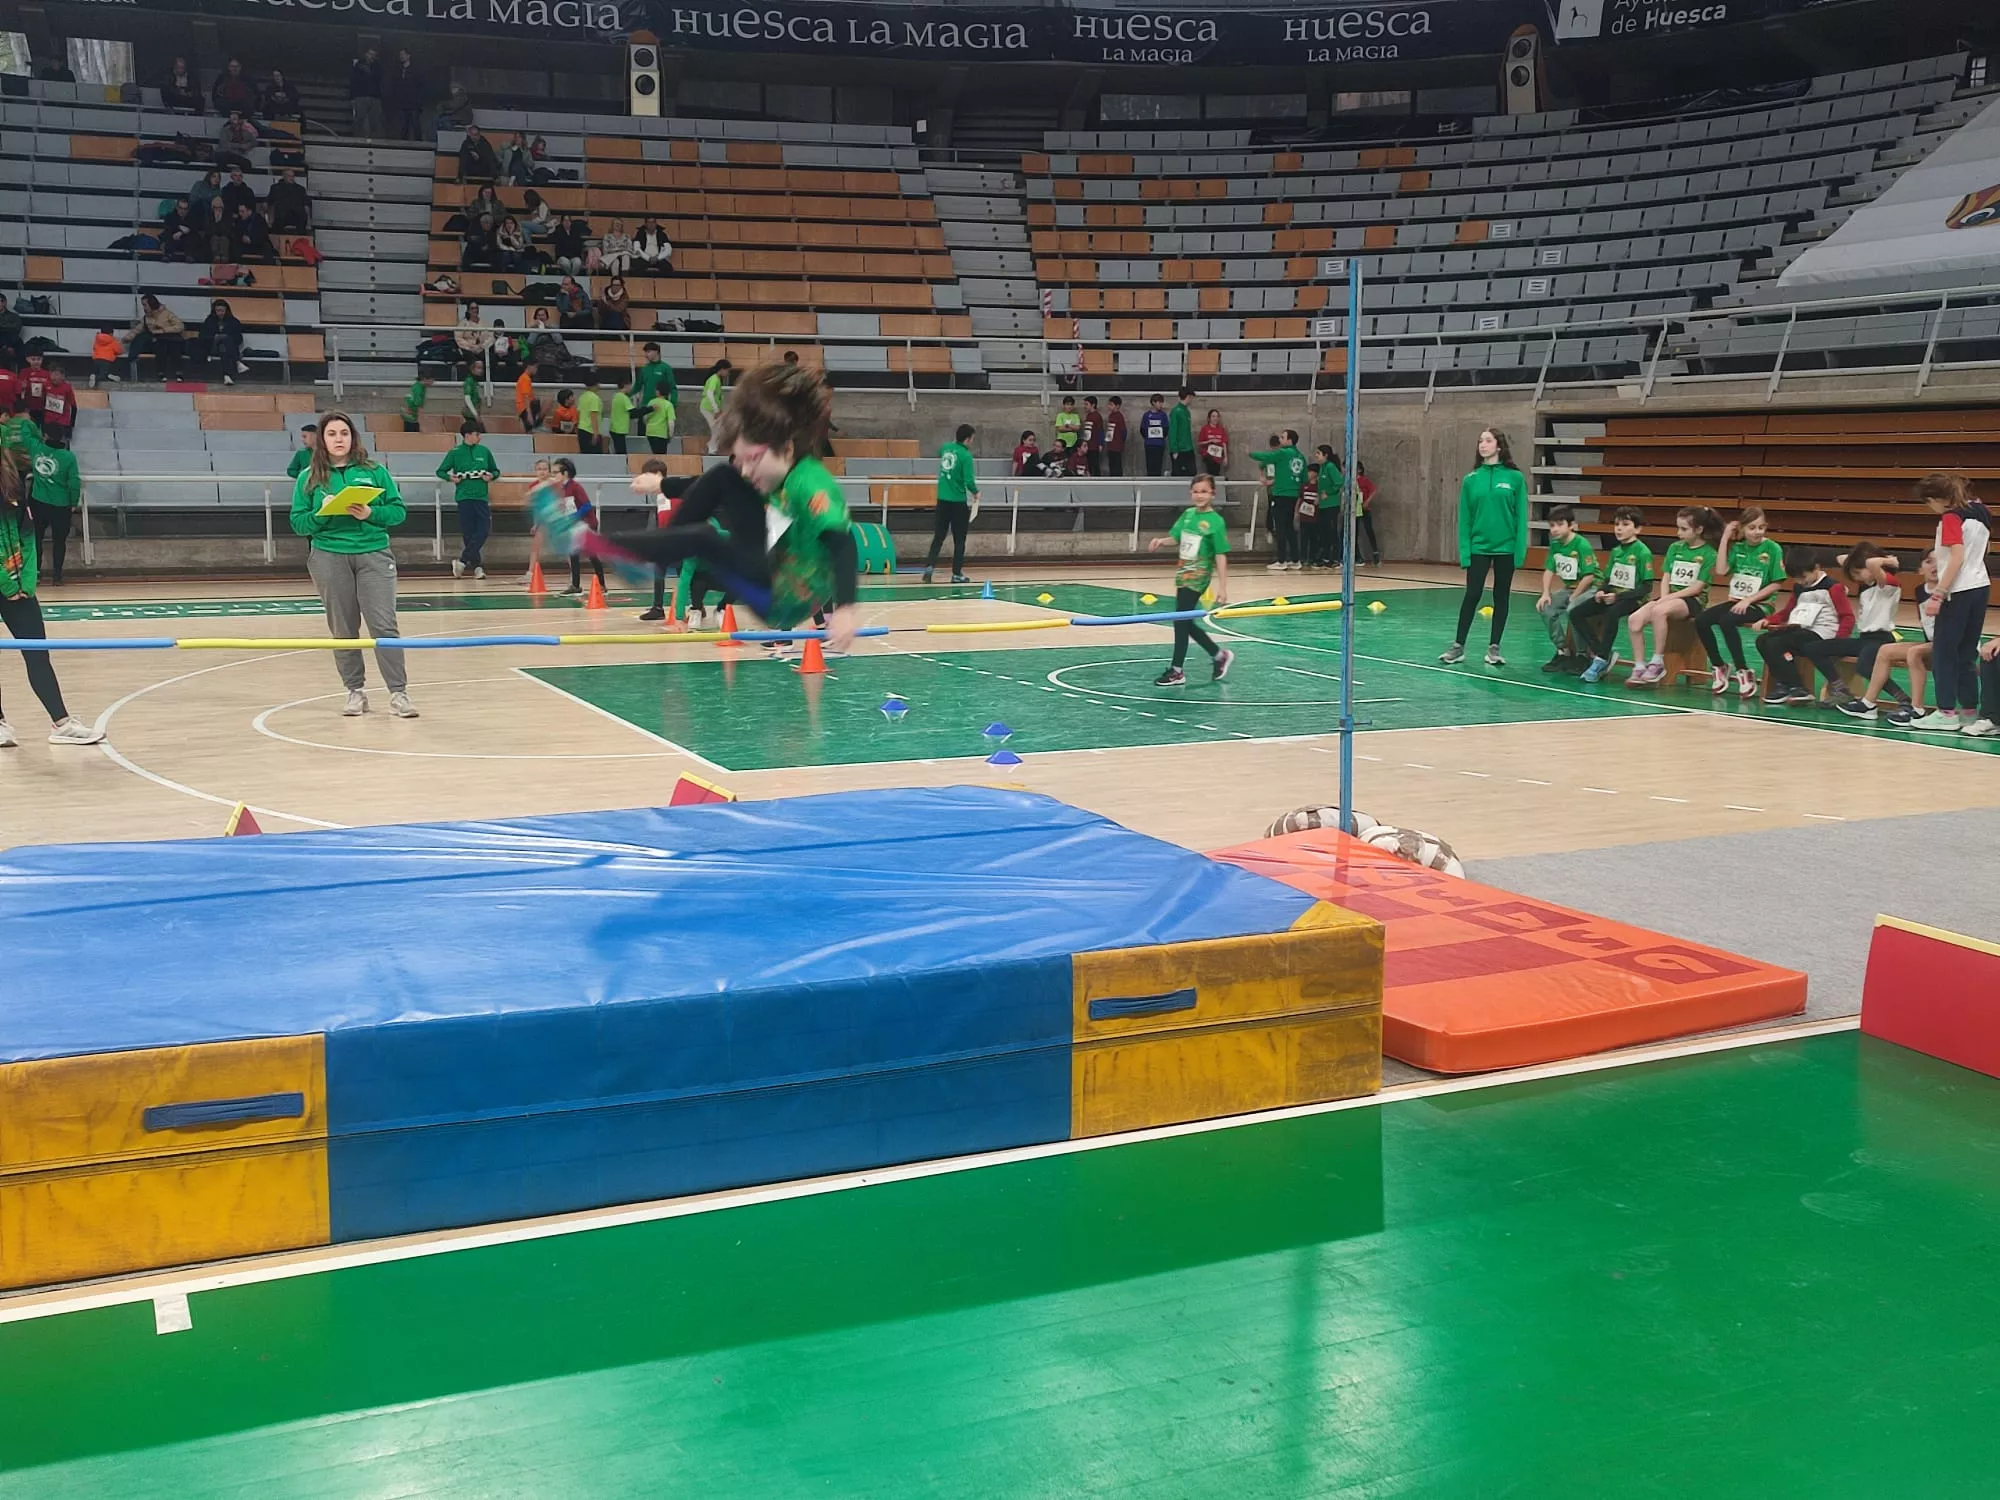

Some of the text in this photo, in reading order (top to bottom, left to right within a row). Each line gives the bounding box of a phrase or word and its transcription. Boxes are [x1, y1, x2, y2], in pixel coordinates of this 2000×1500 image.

[671, 8, 837, 44] Huesca
[847, 18, 895, 45] La
[1283, 9, 1433, 42] Huesca
[1611, 14, 1637, 35] de
[1644, 4, 1727, 31] Huesca
[1072, 14, 1219, 42] Huesca
[1102, 47, 1125, 62] La
[1307, 48, 1331, 63] La
[1613, 569, 1630, 582] 493
[1675, 567, 1694, 579] 494
[1733, 581, 1754, 594] 496
